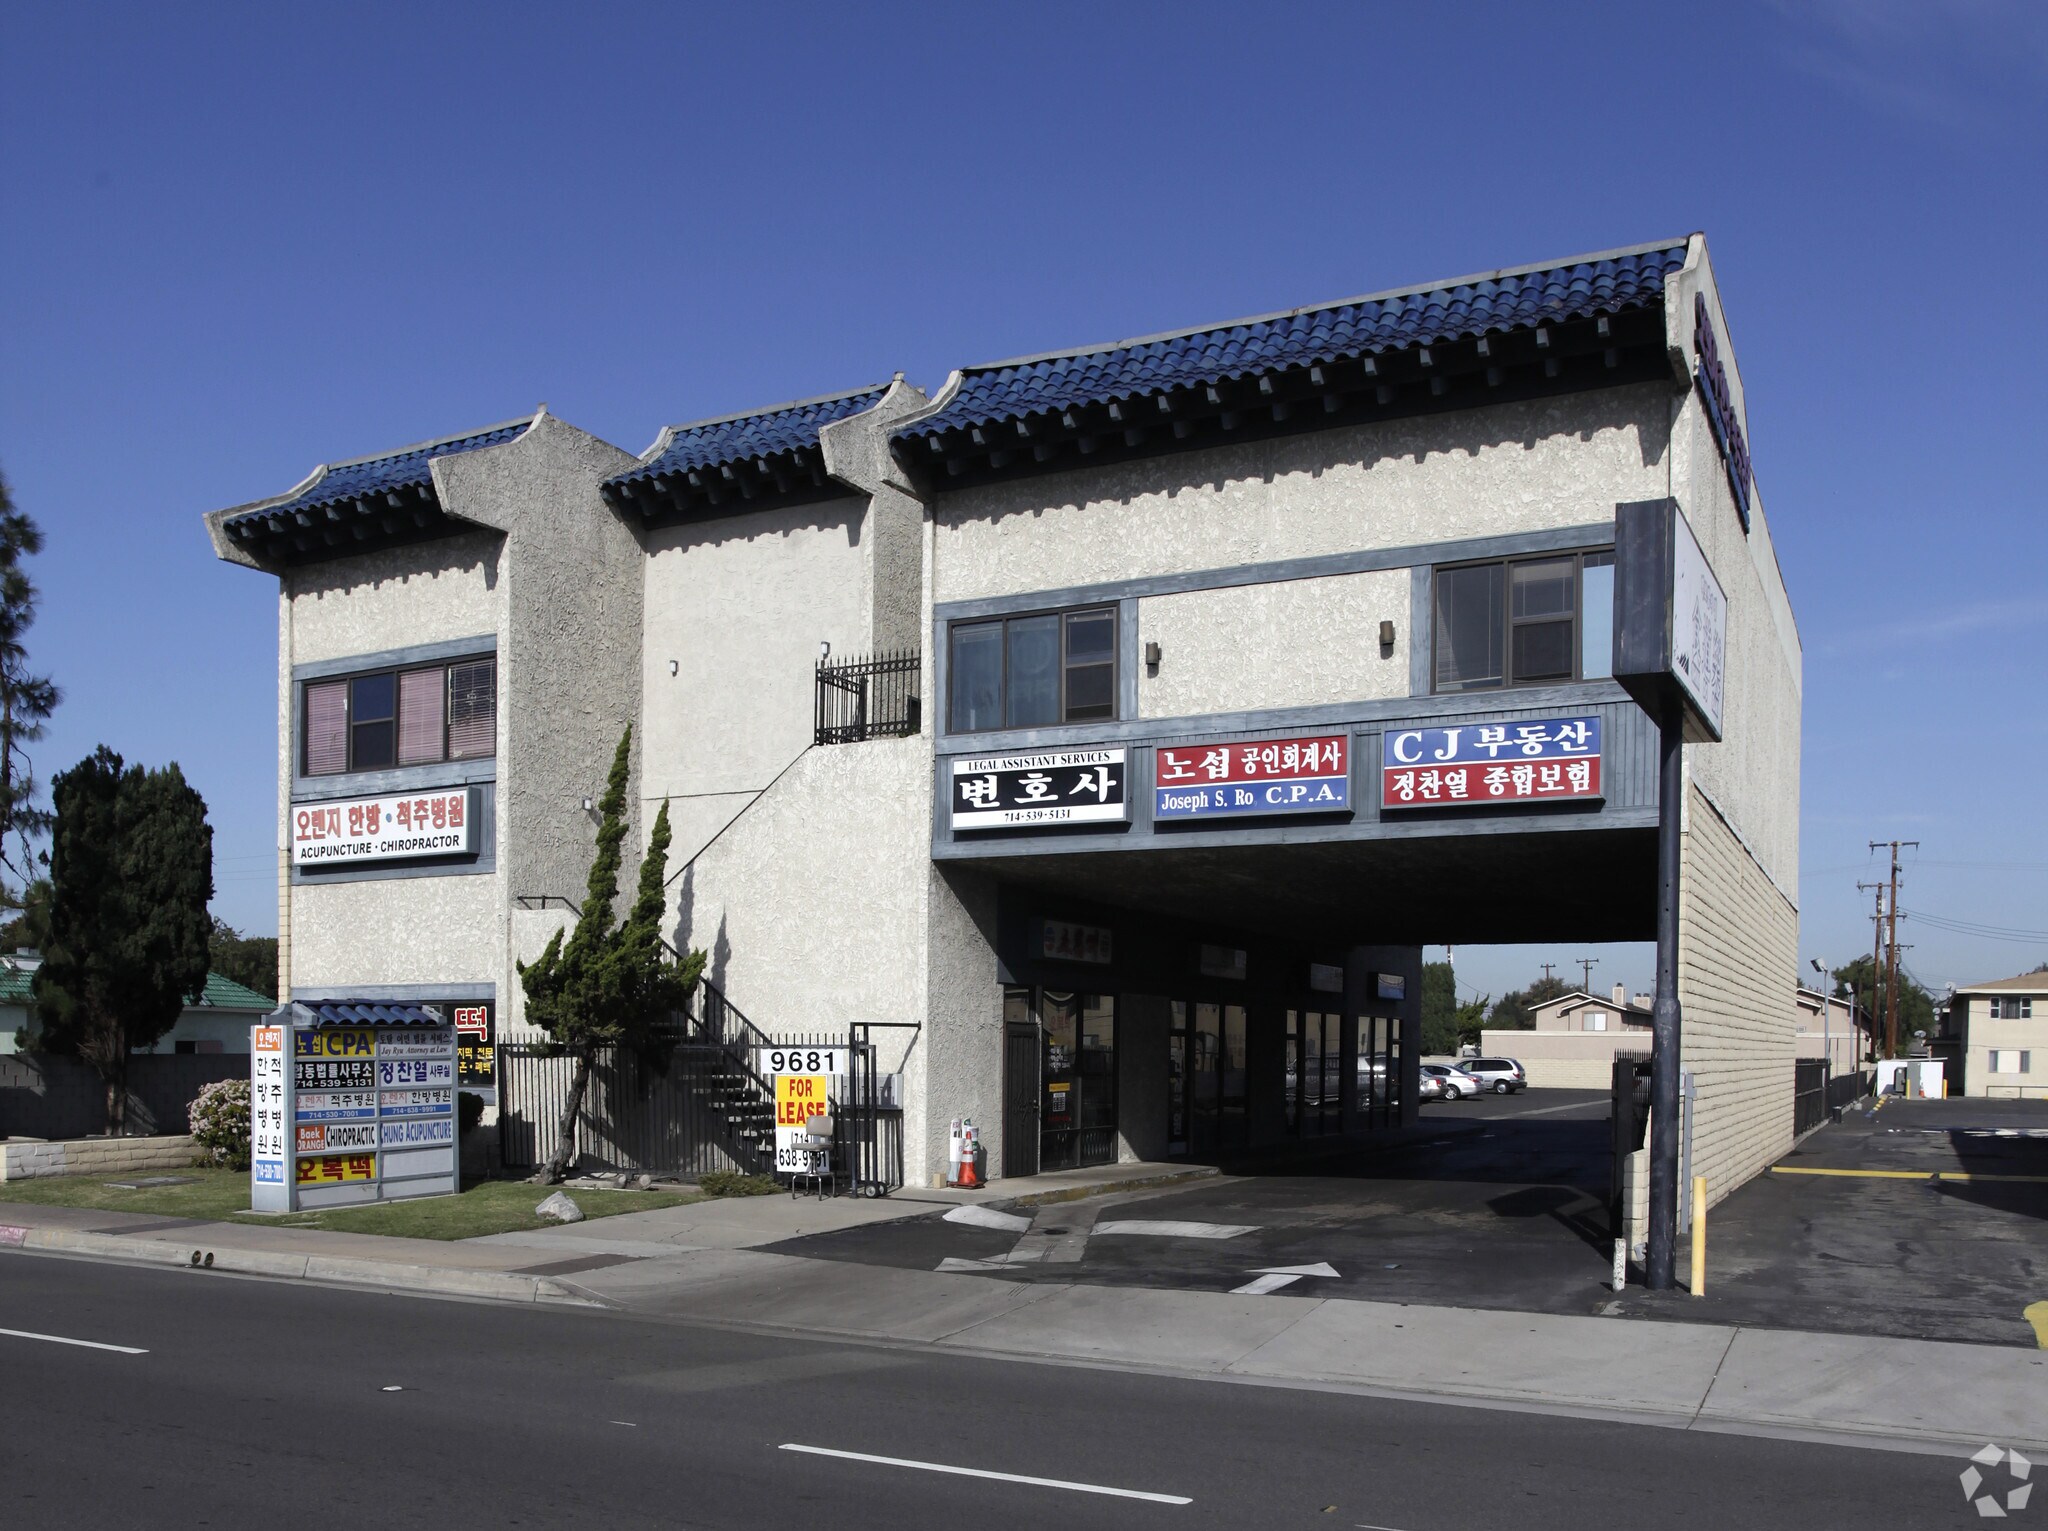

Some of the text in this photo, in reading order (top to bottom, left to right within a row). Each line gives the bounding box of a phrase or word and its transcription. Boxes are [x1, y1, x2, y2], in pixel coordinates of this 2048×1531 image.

[1474, 721, 1592, 757] 부동산
[968, 751, 1110, 771] LEGAL ASSISTANT SERVICES
[1241, 741, 1341, 774] 공인회계사
[959, 766, 1117, 808] 변호사
[1392, 761, 1590, 801] 정찬열 종합보험
[1161, 791, 1209, 812] Joseph
[1215, 790, 1228, 807] S.
[1235, 789, 1254, 806] Ro
[296, 795, 464, 841] 오렌지 한방 척추병원
[301, 835, 460, 859] ACUPUNCTURE CHIROPRACTOR
[455, 1007, 487, 1041] 떡
[258, 1032, 280, 1048] 오렌지
[326, 1032, 372, 1055] CPA
[406, 1046, 429, 1056] Attorney
[437, 1045, 448, 1053] Law
[381, 1061, 450, 1084] 정찬열 사무실
[770, 1051, 834, 1072] 9681
[381, 1089, 451, 1105] 오렌지 한방병원
[789, 1079, 813, 1097] FOR
[296, 1095, 326, 1108] 오렌지
[777, 1102, 825, 1124] LEASE
[326, 1125, 375, 1147] CHIROPRACTIC
[406, 1121, 451, 1141] ACUPUNCTURE
[297, 1140, 325, 1151] ORANGE
[296, 1155, 371, 1181] 오복떡
